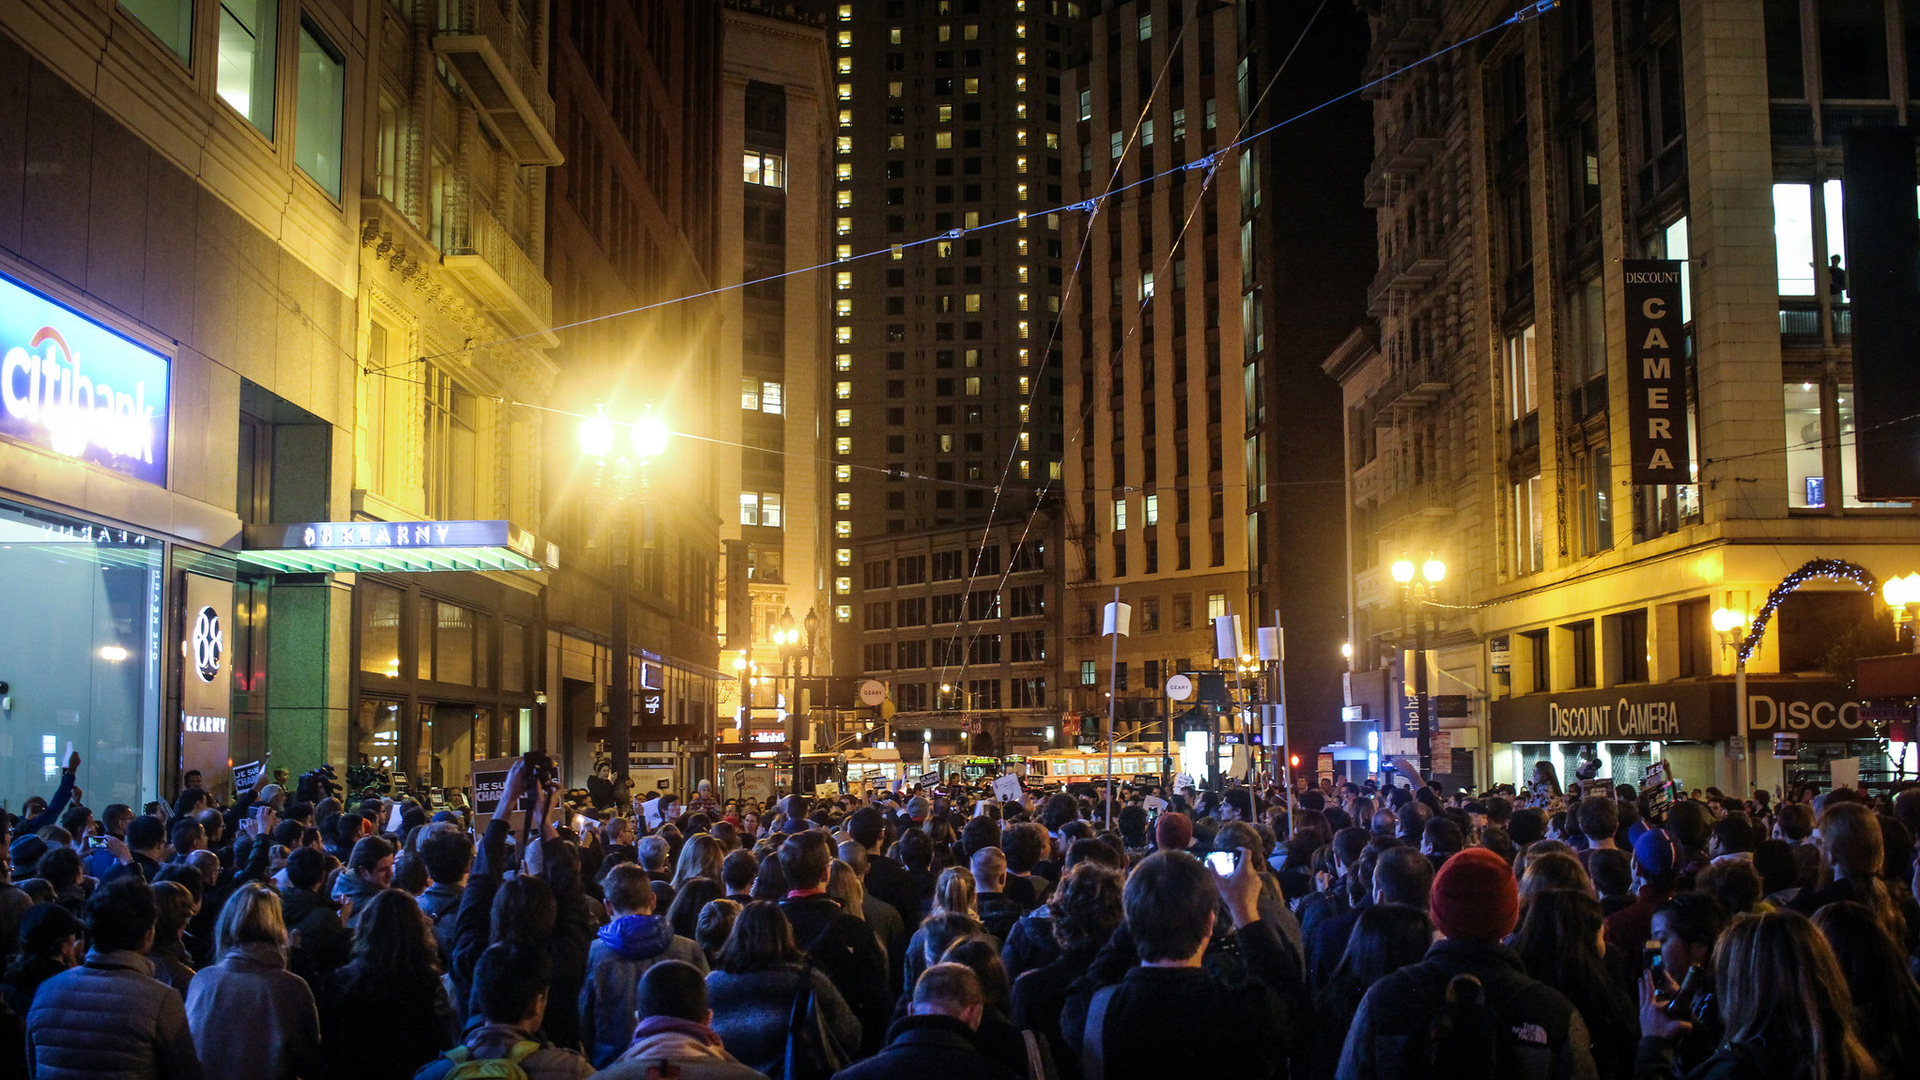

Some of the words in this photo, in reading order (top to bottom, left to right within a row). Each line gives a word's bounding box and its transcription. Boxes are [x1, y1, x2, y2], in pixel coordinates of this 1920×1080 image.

[1626, 272, 1680, 284] DISCOUNT
[1642, 297, 1675, 470] CAMERA
[2, 344, 154, 465] citibank
[342, 523, 449, 546] KEARNY
[185, 716, 227, 732] KEARNY
[1549, 701, 1612, 737] DISCOUNT
[1617, 697, 1680, 736] CAMERA
[235, 771, 247, 779] JE
[246, 766, 260, 776] SUIS
[476, 783, 490, 791] JE
[491, 781, 507, 790] SU
[476, 790, 503, 802] CHAR
